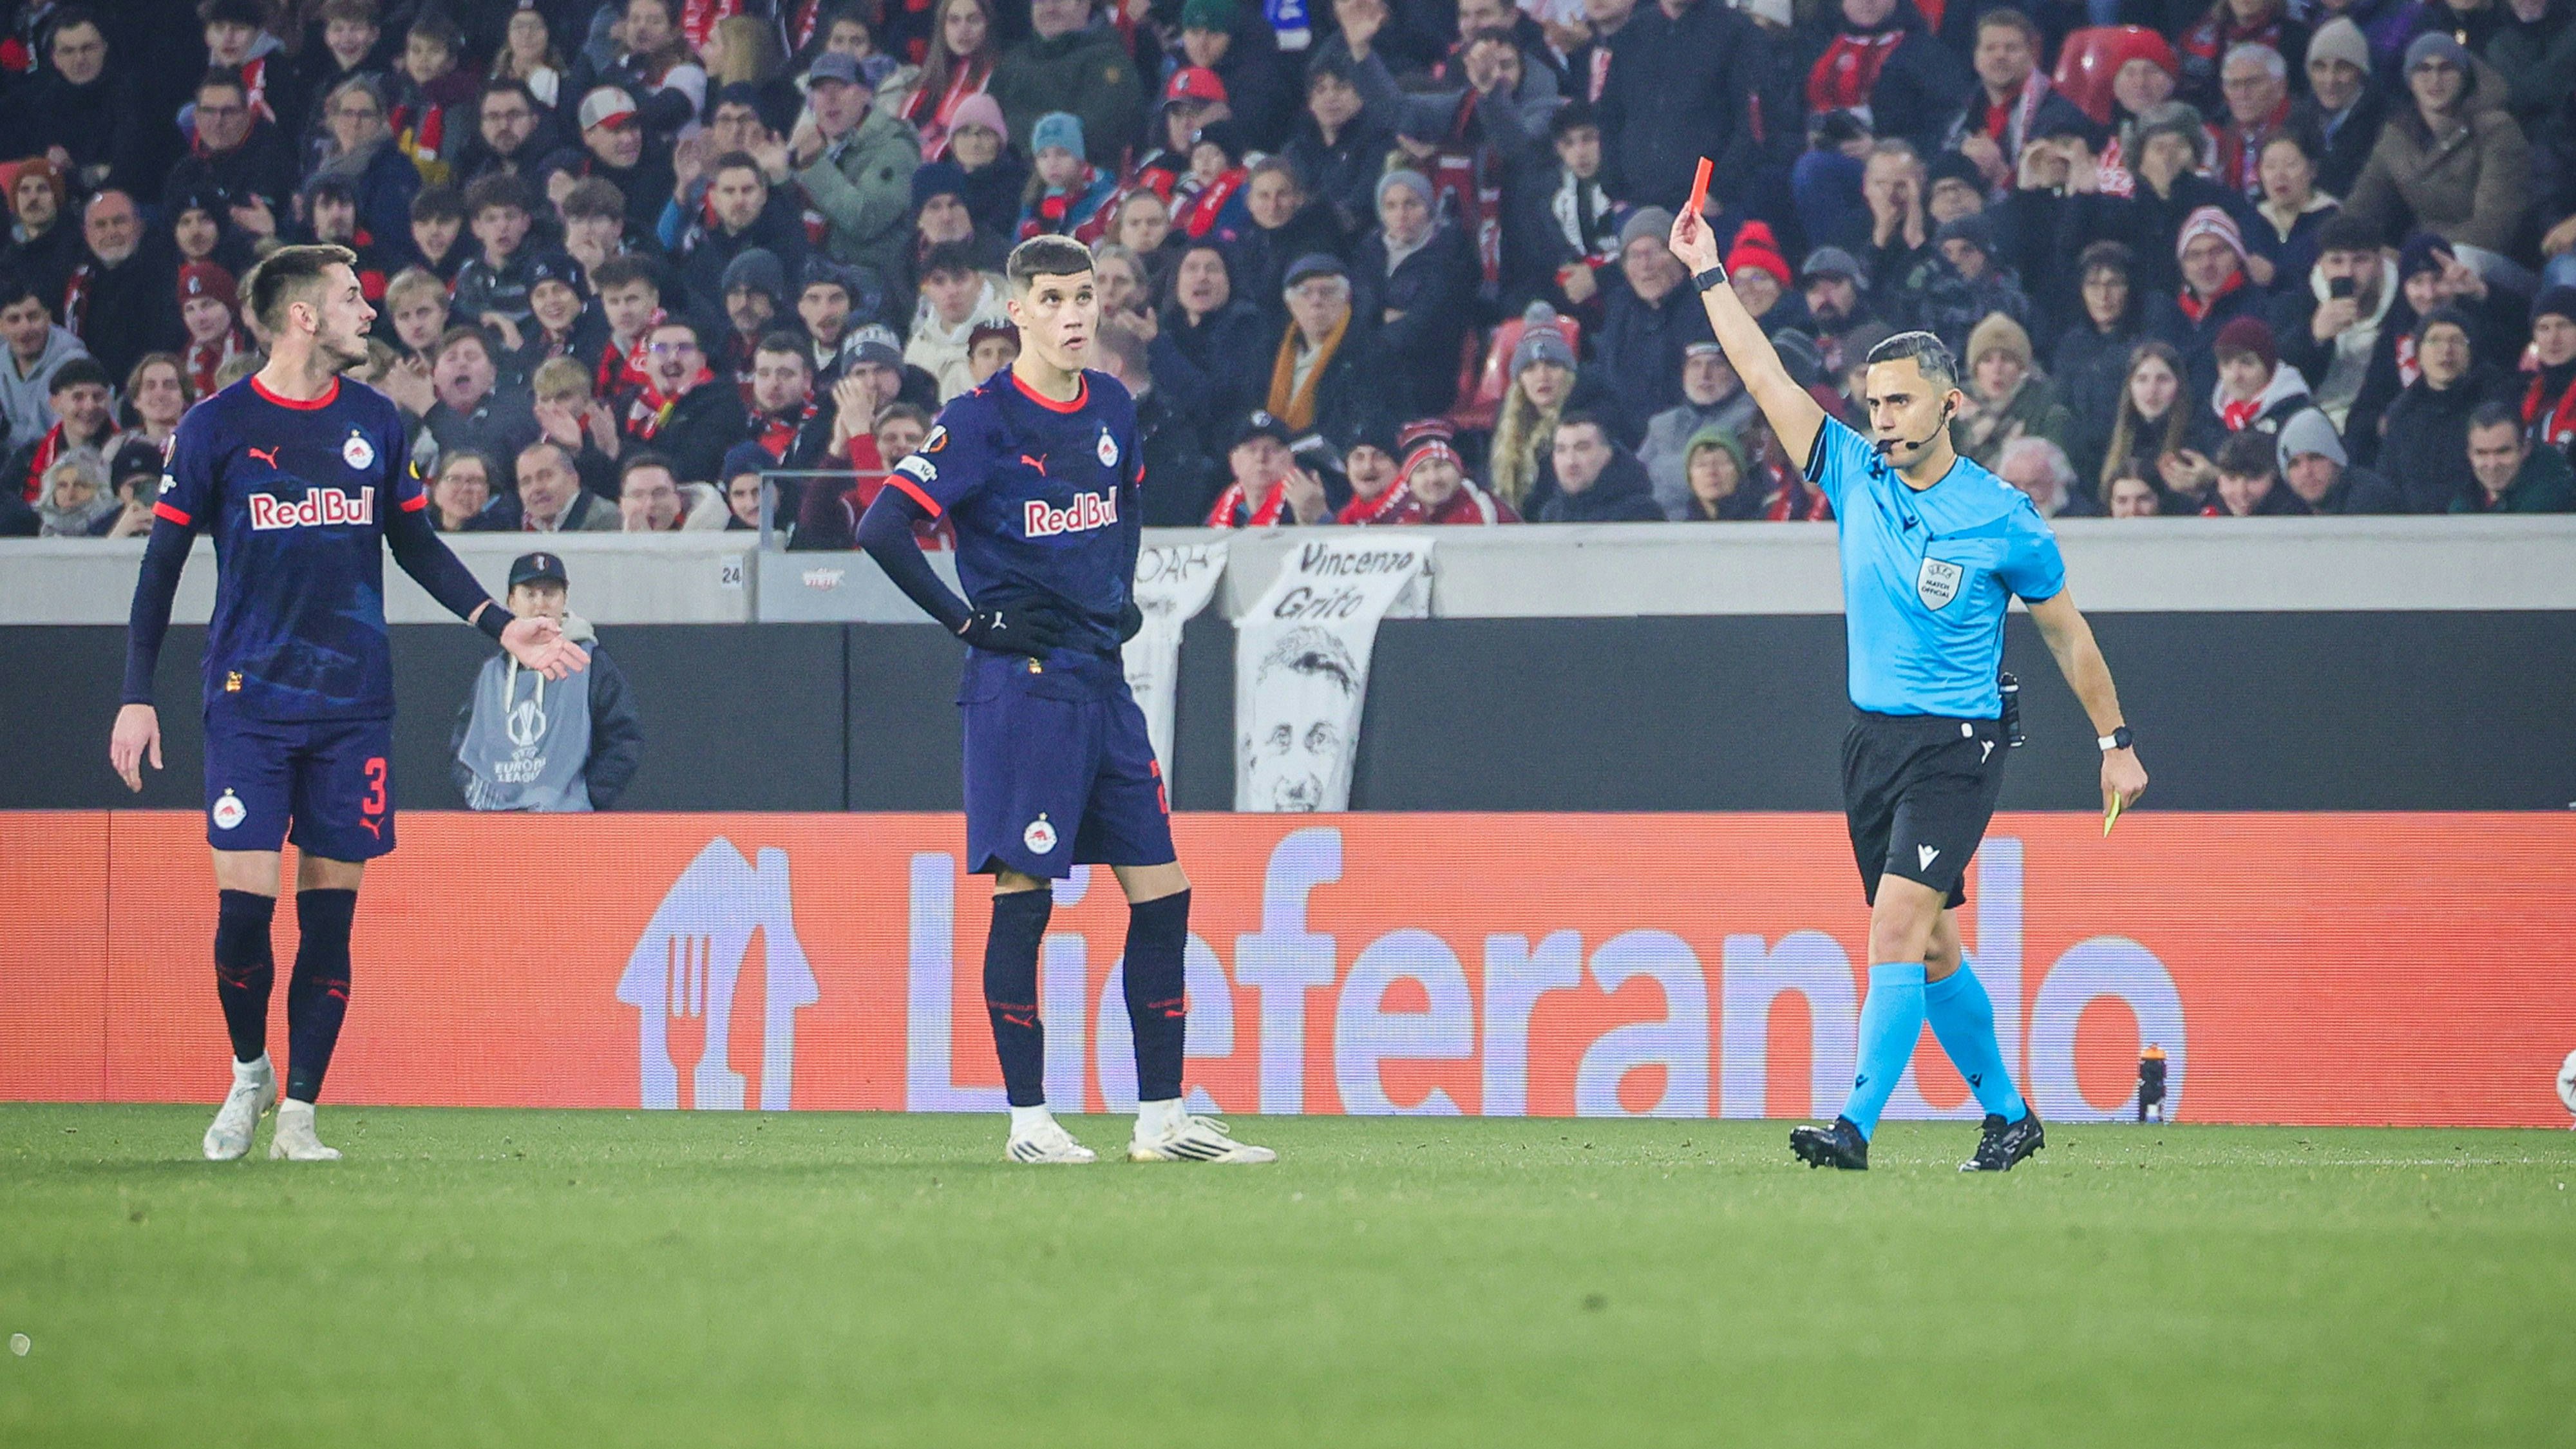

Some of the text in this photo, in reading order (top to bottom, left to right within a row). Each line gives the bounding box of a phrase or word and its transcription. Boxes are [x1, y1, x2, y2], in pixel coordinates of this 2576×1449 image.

[1301, 543, 1414, 576] Vincenzo
[722, 567, 741, 583] 24
[1926, 580, 1949, 590] MATCH
[1921, 586, 1949, 598] OFFICIAL
[362, 757, 387, 815] 3
[906, 827, 2186, 1122] Lieferando
